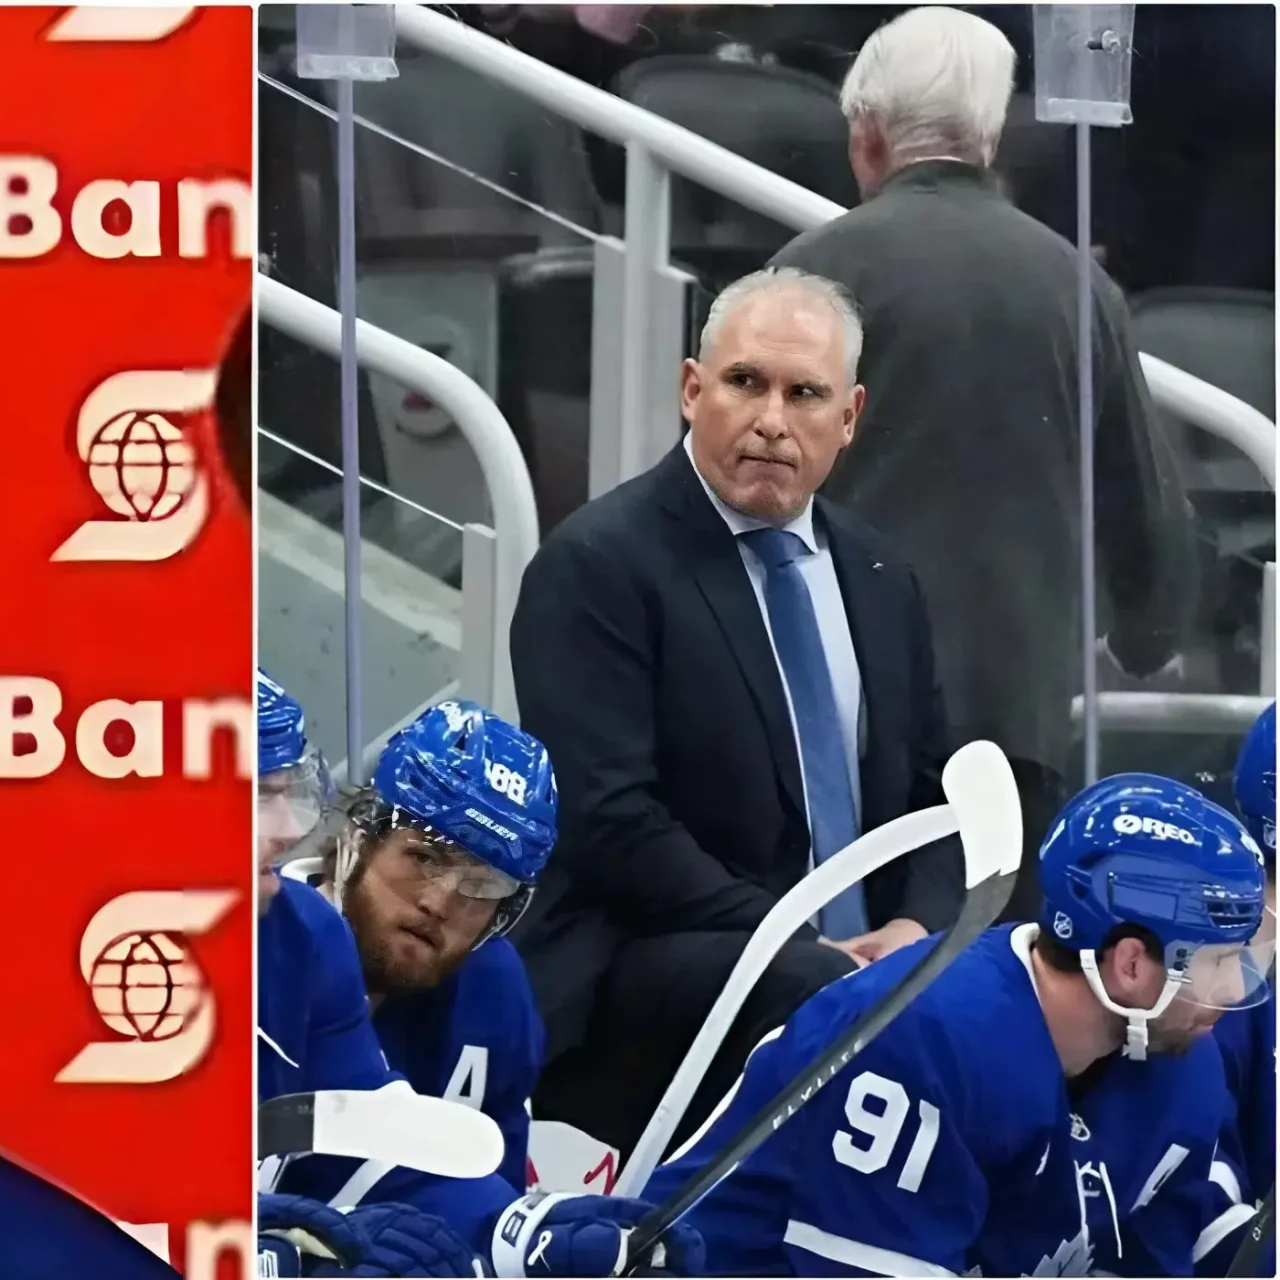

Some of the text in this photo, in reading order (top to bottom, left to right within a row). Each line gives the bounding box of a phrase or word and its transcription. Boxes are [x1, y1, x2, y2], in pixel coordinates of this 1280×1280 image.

[1113, 814, 1196, 845] OREO
[442, 1045, 488, 1112] A
[832, 1071, 940, 1193] 91
